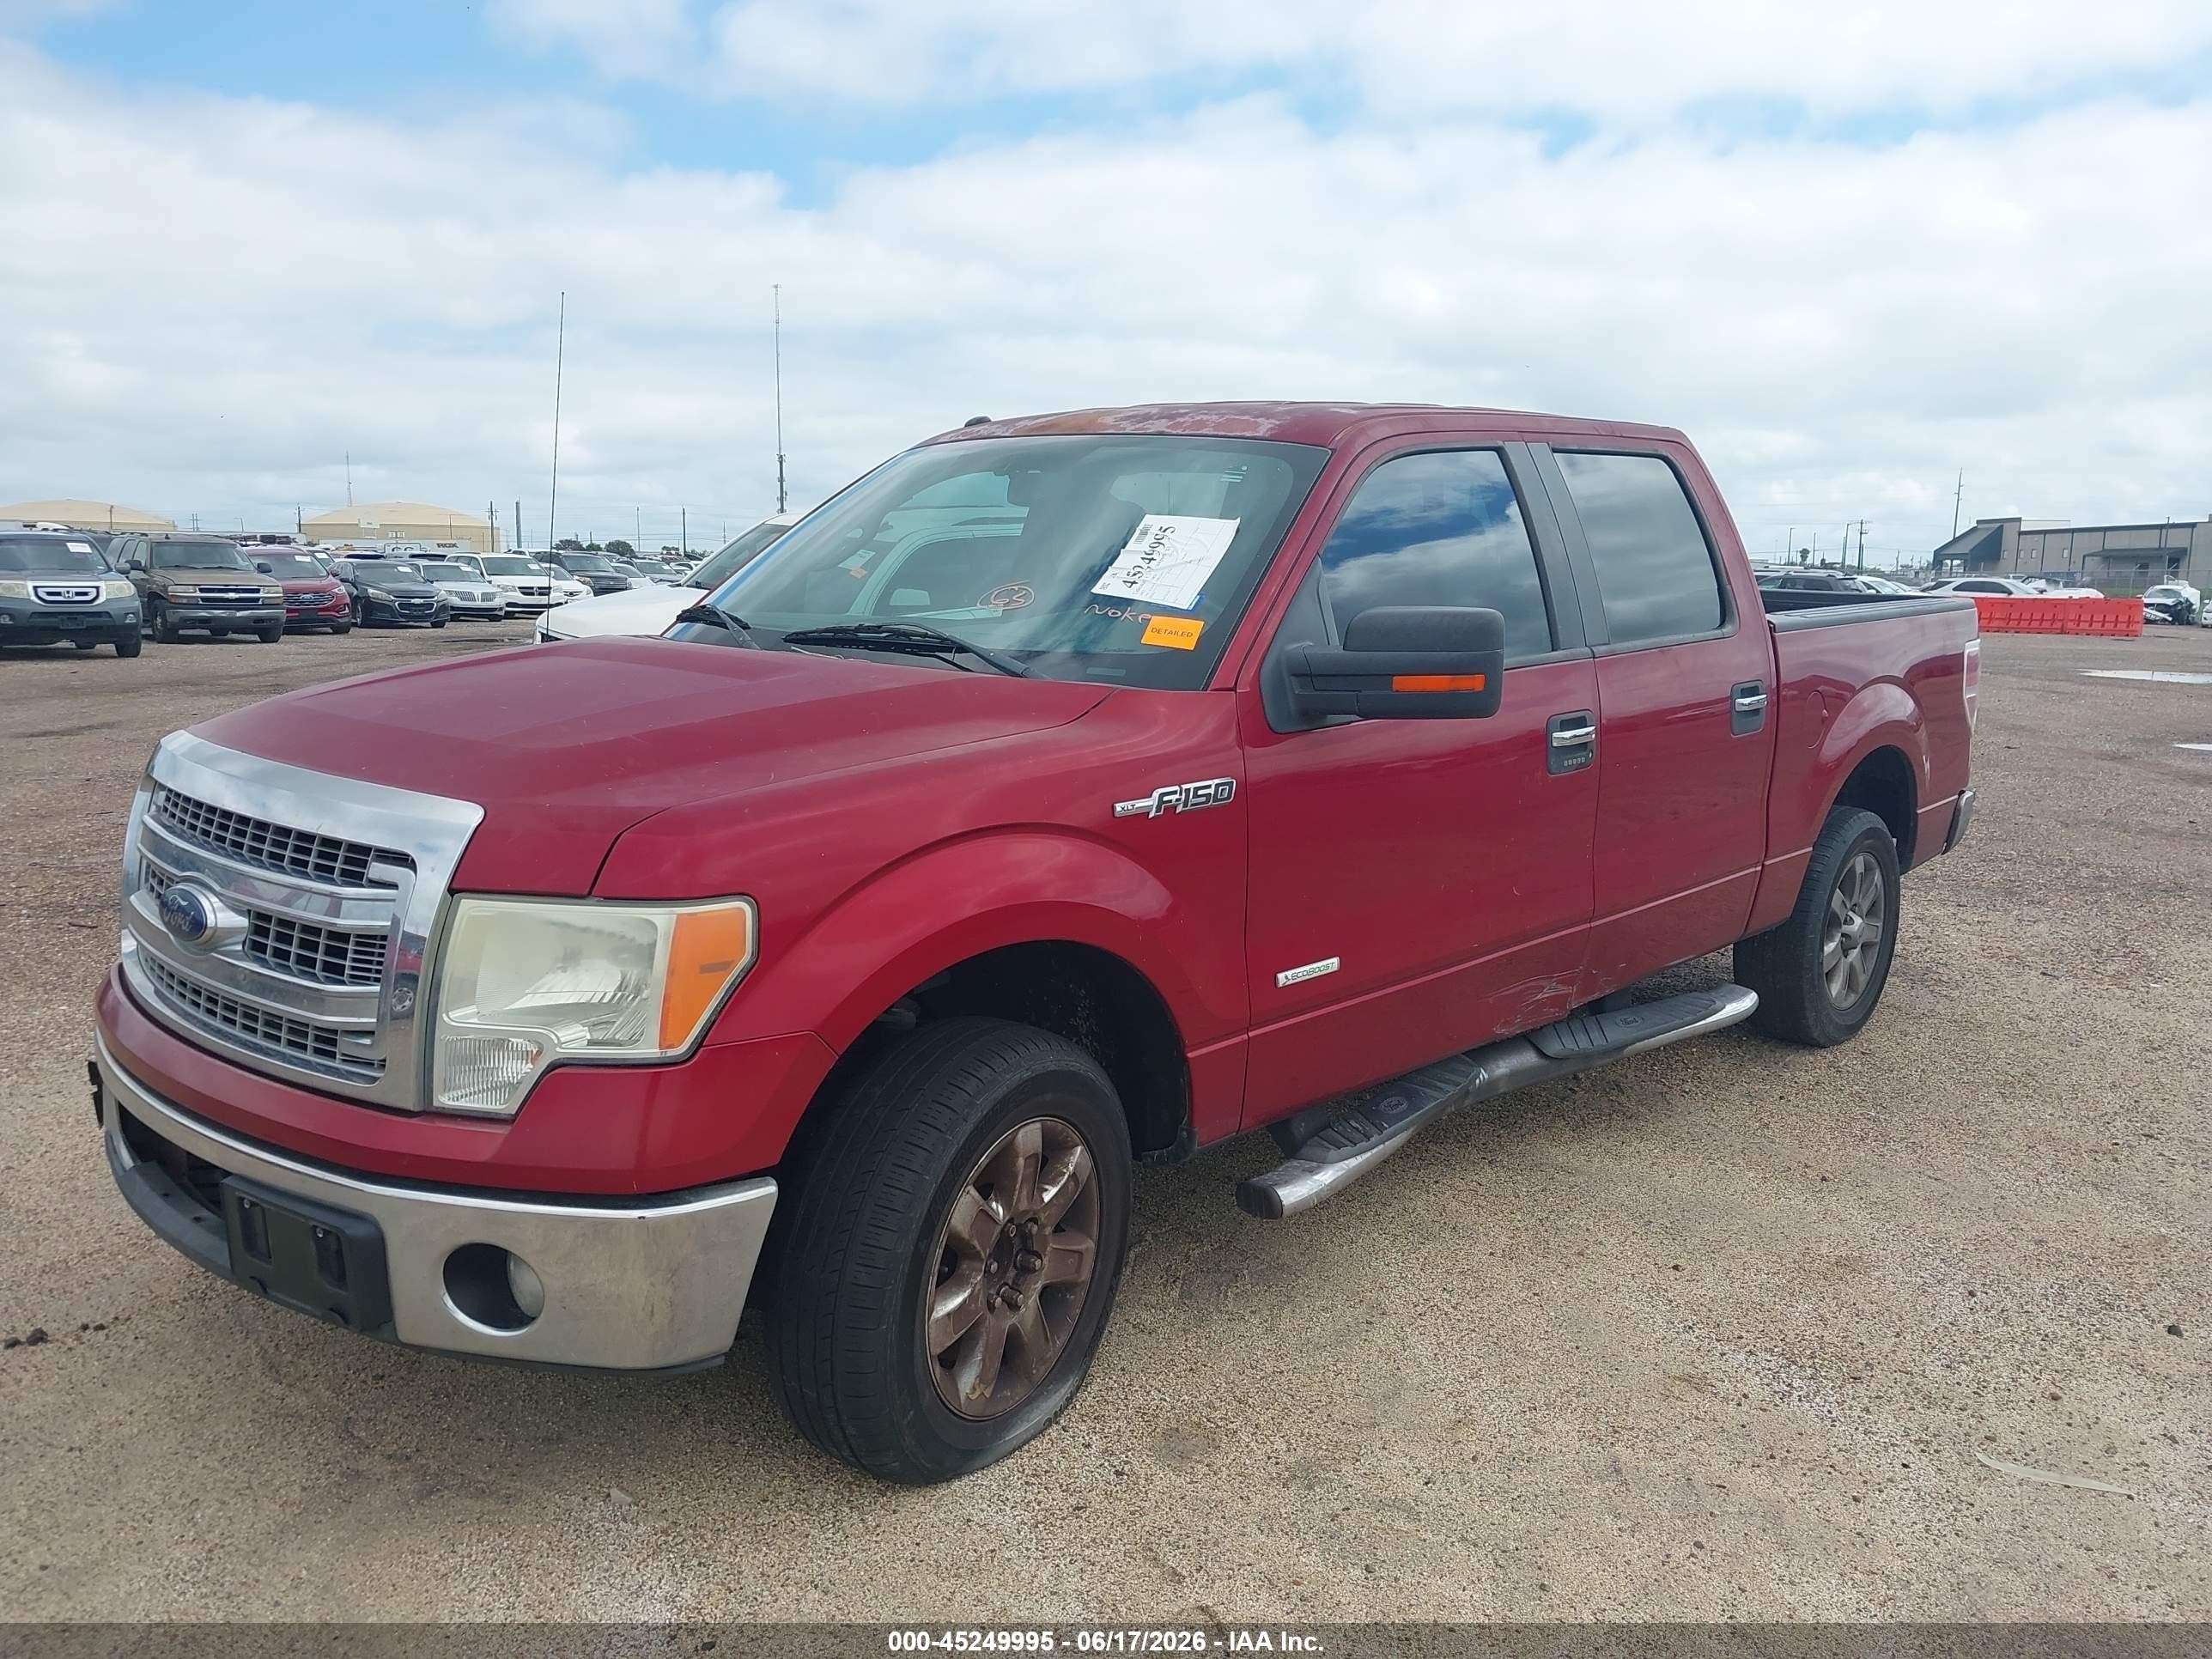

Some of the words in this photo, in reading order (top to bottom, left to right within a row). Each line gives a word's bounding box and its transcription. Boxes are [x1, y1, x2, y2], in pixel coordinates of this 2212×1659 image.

[1151, 627, 1194, 638] DETAILED
[1120, 804, 1136, 812] XLT
[1150, 778, 1237, 818] F-150
[164, 894, 195, 933] Ford
[1291, 962, 1335, 981] ECOBOOST
